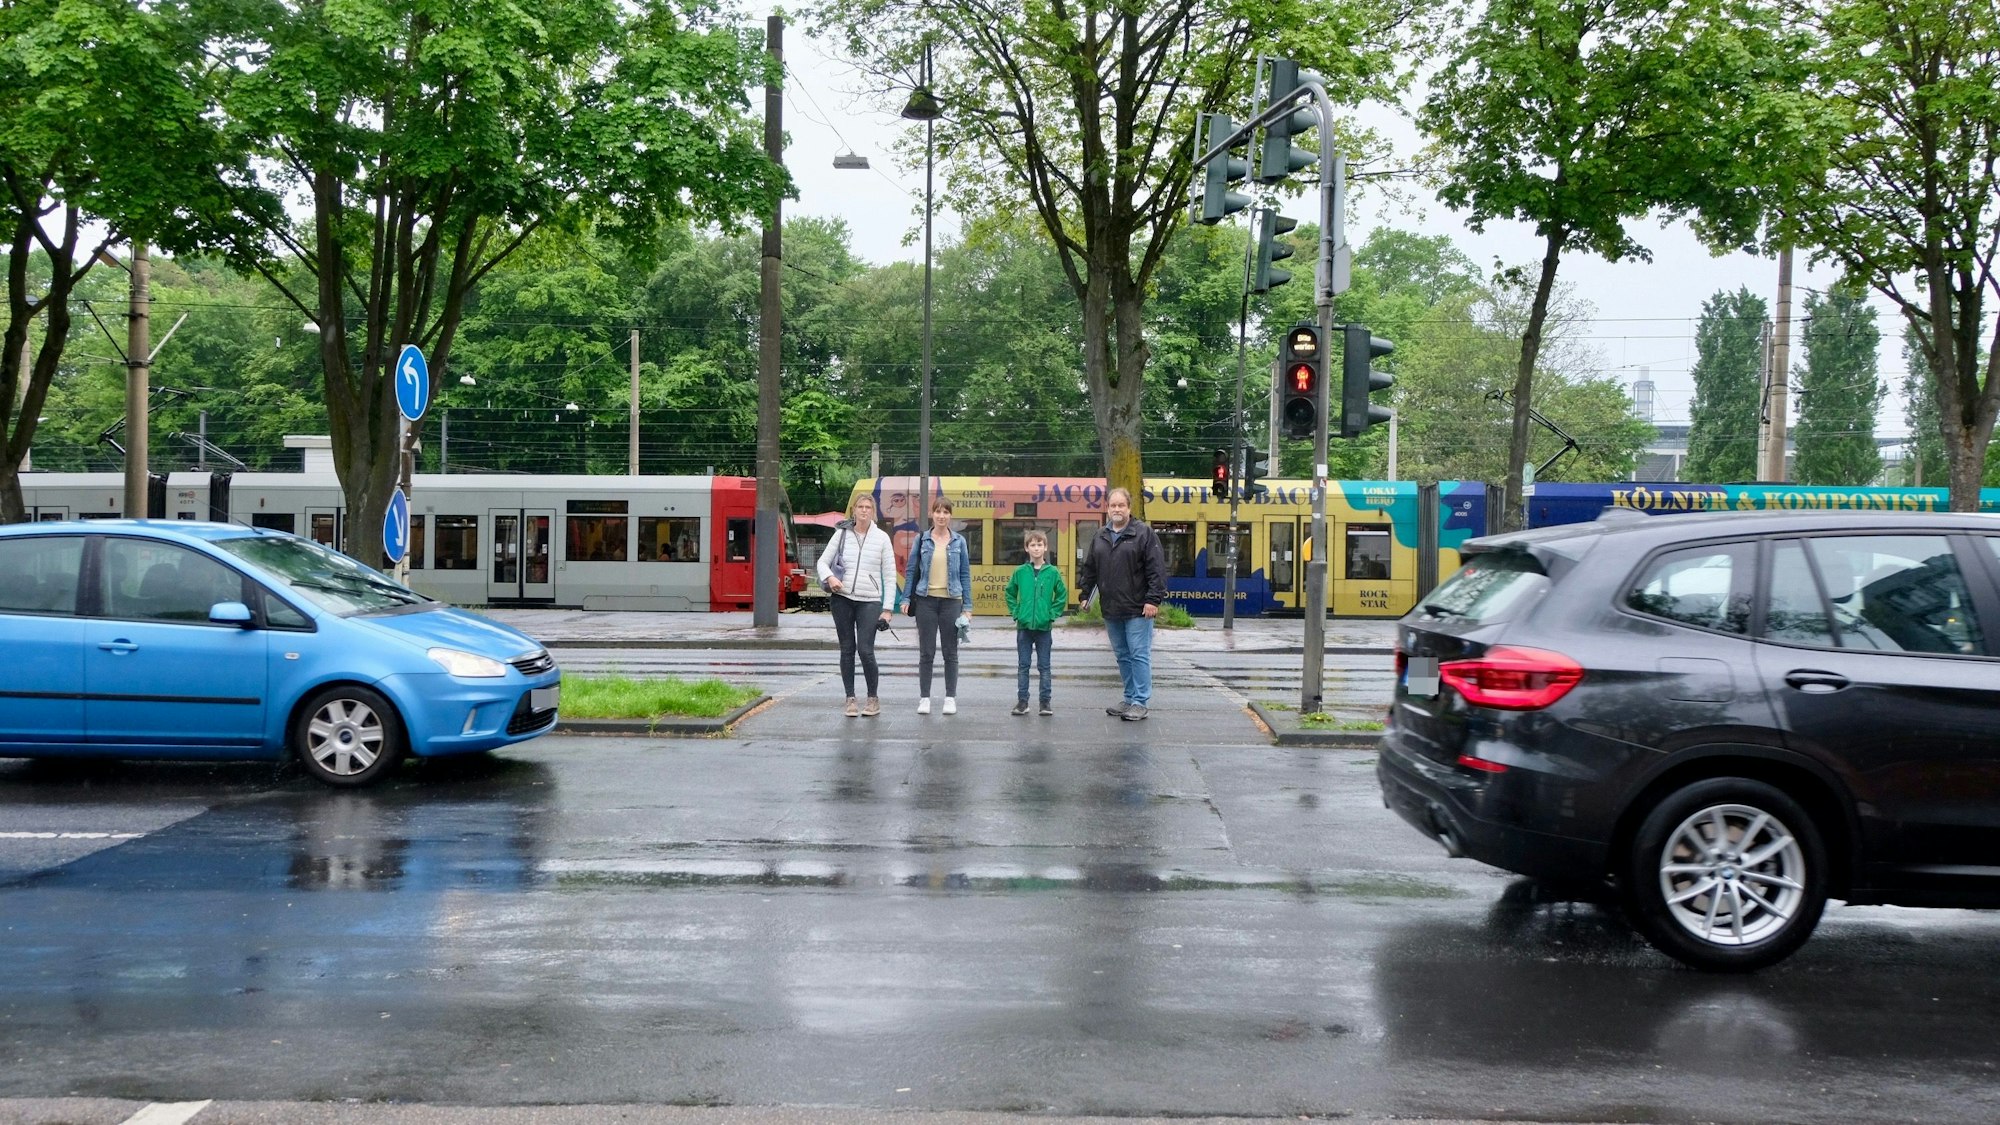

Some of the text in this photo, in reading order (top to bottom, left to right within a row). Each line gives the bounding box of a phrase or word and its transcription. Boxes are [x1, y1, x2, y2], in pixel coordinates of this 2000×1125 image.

[962, 490, 993, 499] GENIE
[1362, 487, 1398, 495] LOKAL
[1032, 483, 1155, 509] JACQS
[1611, 486, 1941, 513] KÖLNER & KOMPONIST
[972, 575, 1010, 583] JACQUES
[1163, 591, 1248, 600] OFFENBACHJHR
[1360, 590, 1388, 598] ROCK
[1360, 600, 1389, 609] STAR
